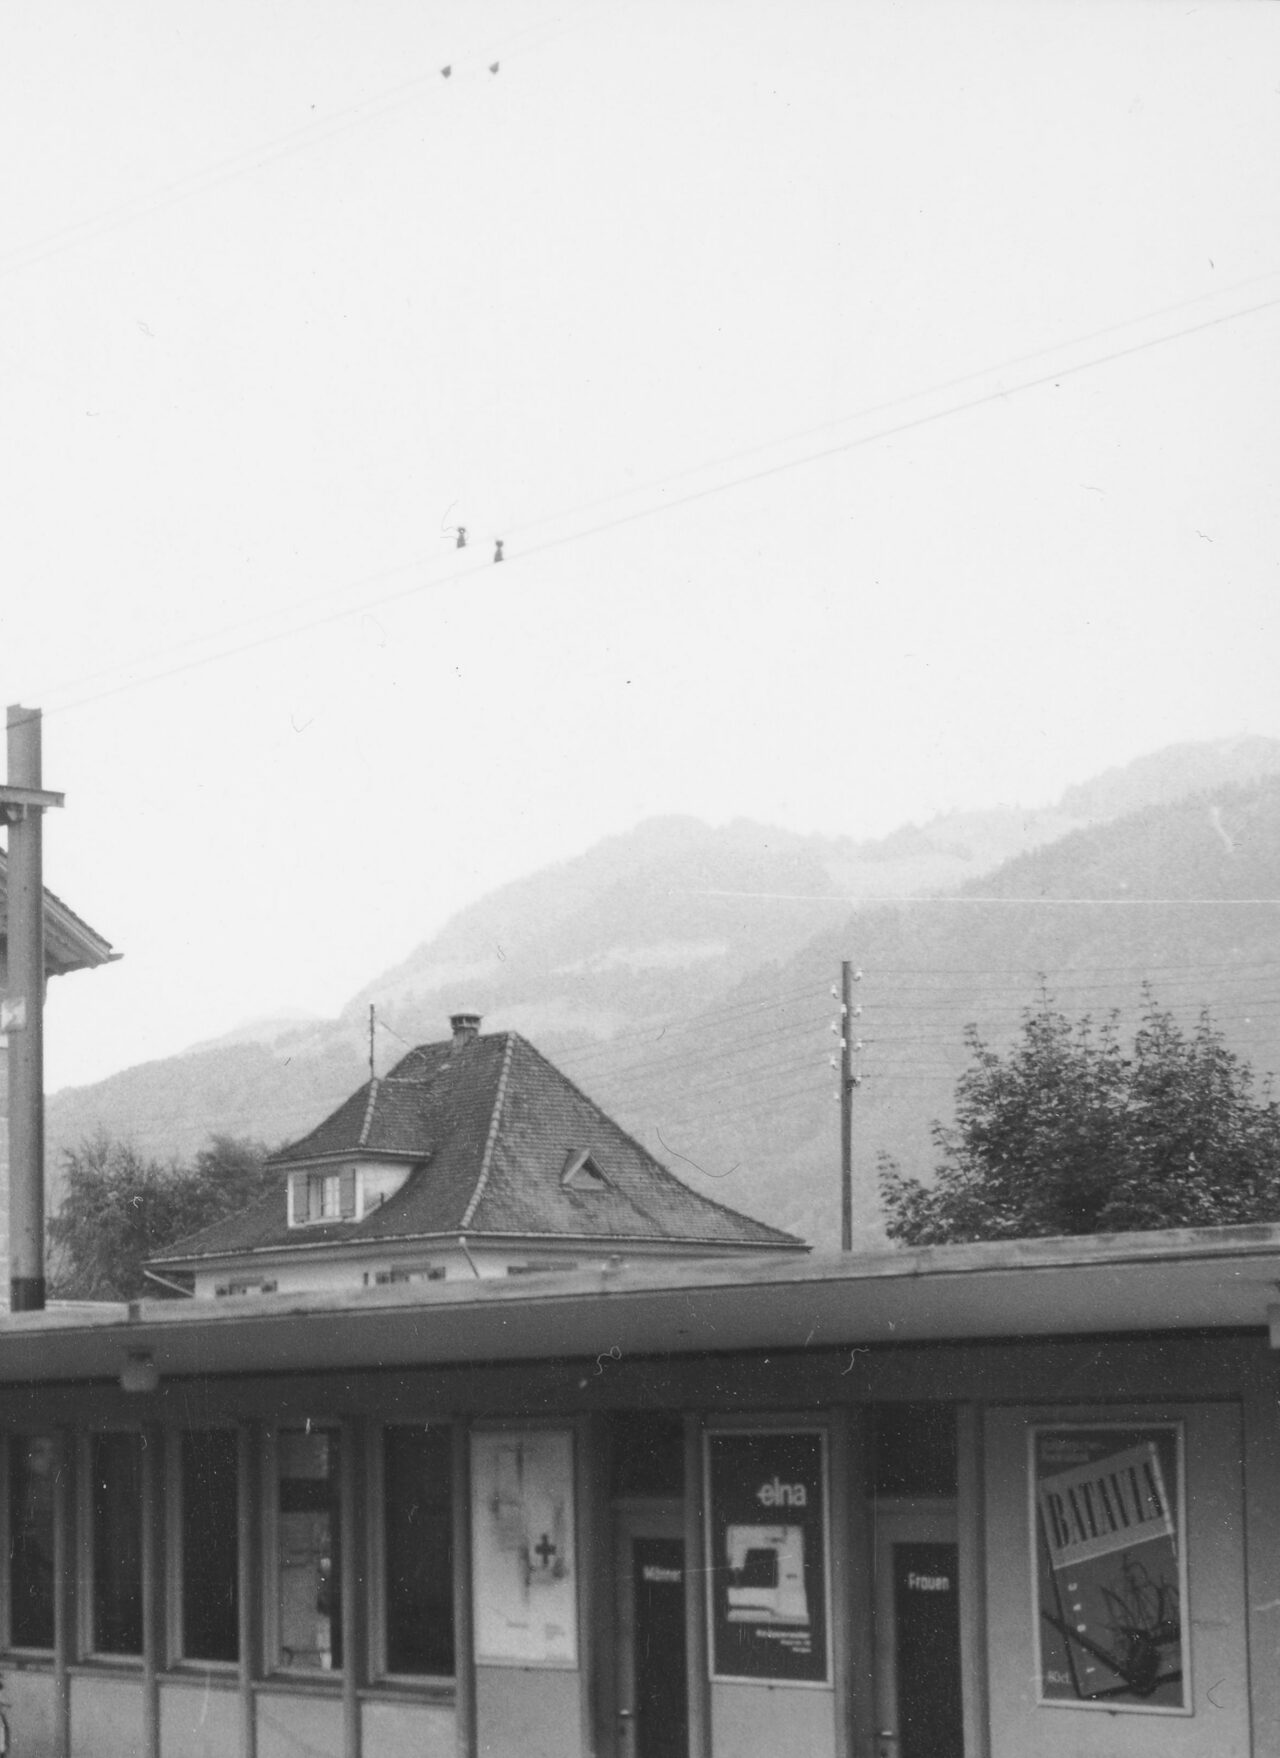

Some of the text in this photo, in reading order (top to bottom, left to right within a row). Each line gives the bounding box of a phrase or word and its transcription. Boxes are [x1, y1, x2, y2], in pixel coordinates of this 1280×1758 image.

[757, 1477, 808, 1507] elna
[1045, 1461, 1164, 1550] BATAVIA
[907, 1572, 950, 1591] Frauen
